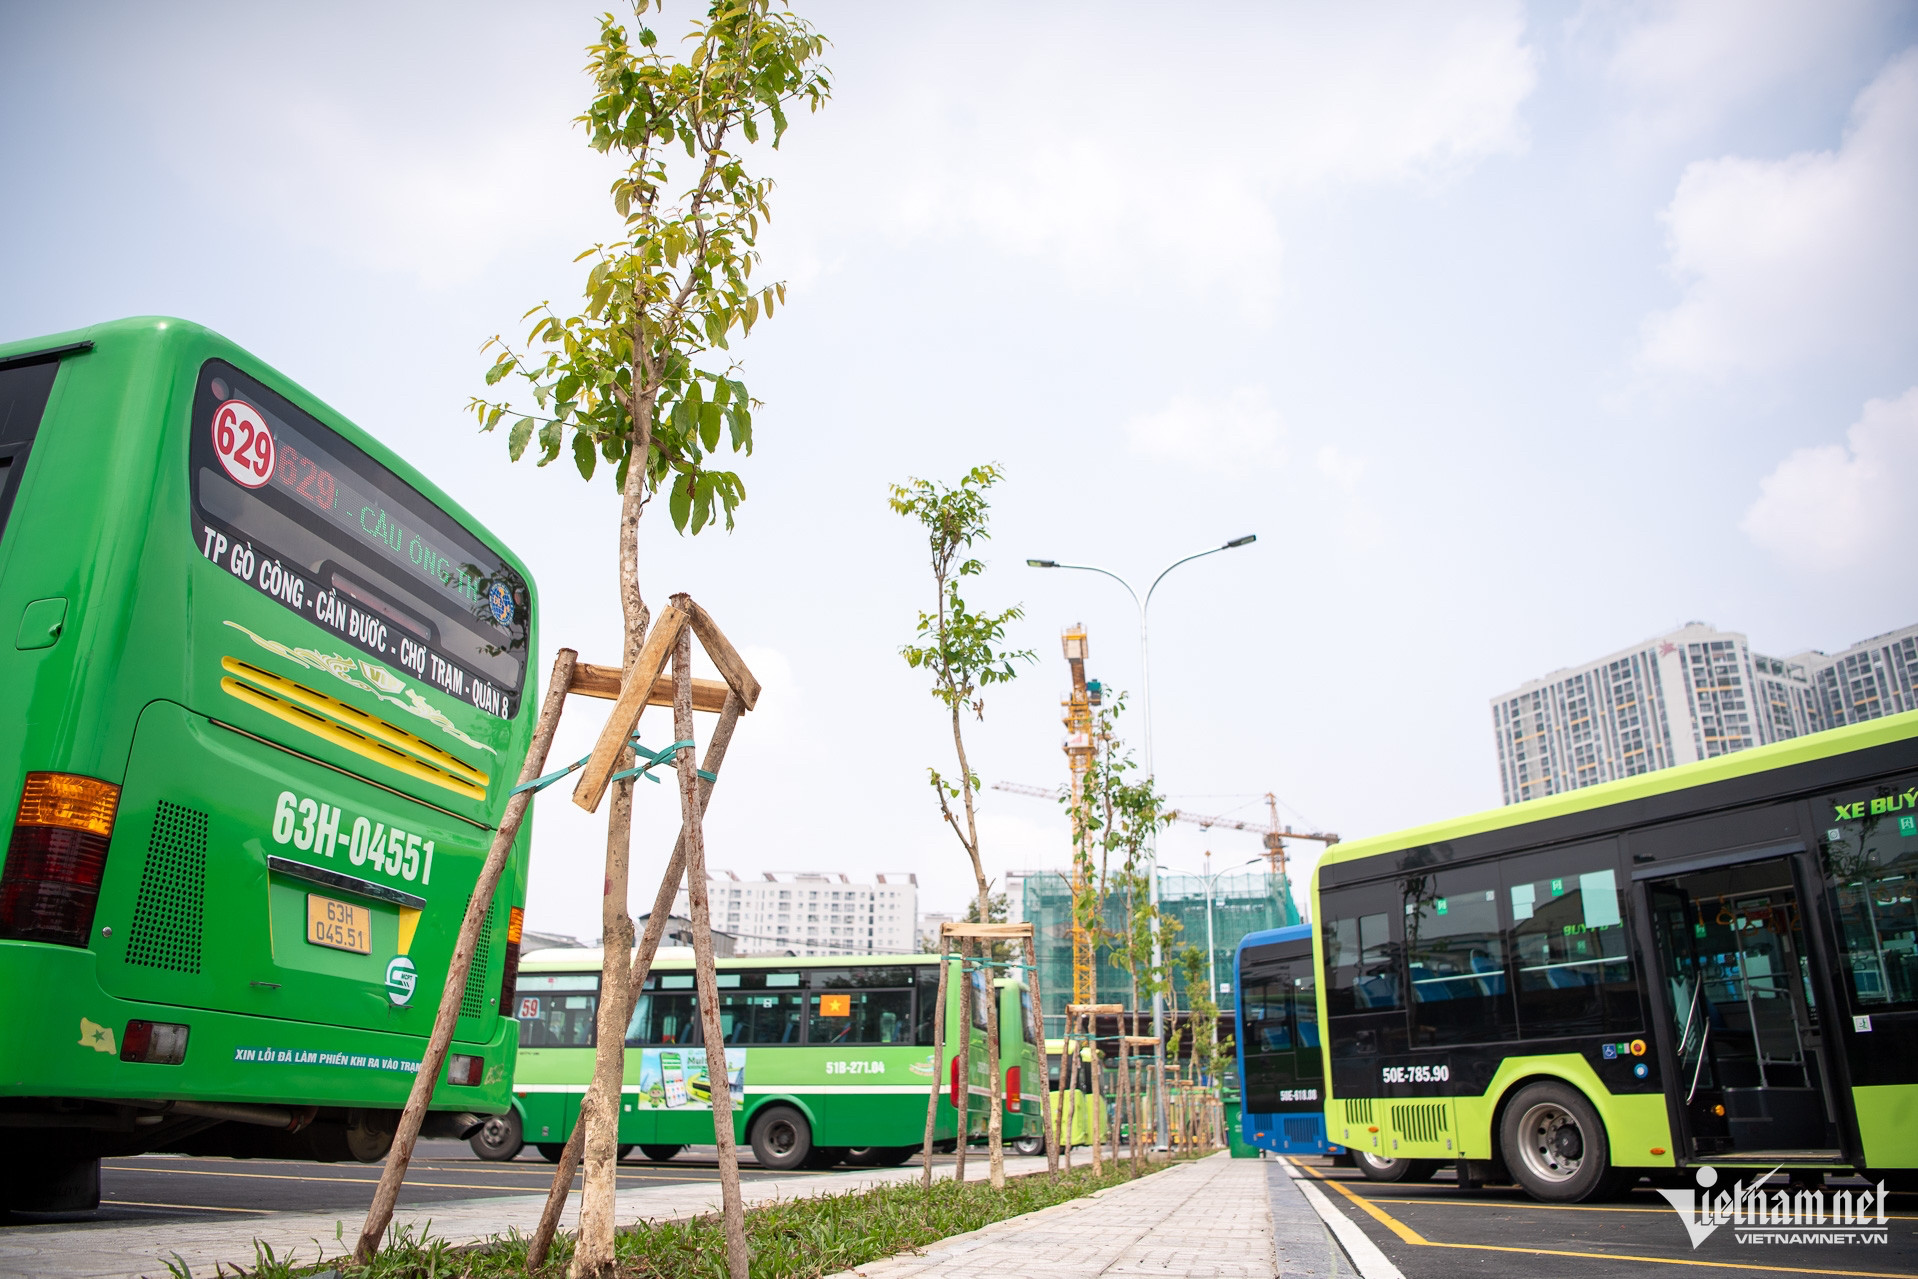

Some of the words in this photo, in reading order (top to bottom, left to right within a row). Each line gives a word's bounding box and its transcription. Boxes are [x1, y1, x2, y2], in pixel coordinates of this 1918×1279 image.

[217, 408, 271, 477] 629
[279, 445, 335, 510] 629
[409, 534, 450, 584] ÔNG
[203, 525, 228, 564] TP
[230, 541, 255, 581] GÒ
[259, 559, 304, 610] CÔNG
[400, 637, 427, 680] CHỢ
[430, 653, 464, 696] TRẠM
[472, 678, 500, 716] QUẬN
[501, 696, 509, 720] 8
[1834, 801, 1866, 822] XE
[1870, 786, 1918, 815] BUÝ
[272, 790, 435, 886] 63H-04551
[327, 902, 354, 926] 63H
[316, 921, 363, 949] 045.51
[521, 999, 539, 1017] 59
[234, 1048, 256, 1061] XIN
[257, 1046, 275, 1062] LỖI
[277, 1050, 293, 1062] ĐÃ
[294, 1050, 317, 1064] LÀM
[350, 1056, 366, 1067] KHI
[367, 1057, 380, 1069] RA
[381, 1057, 399, 1070] VÀO
[1382, 1065, 1450, 1083] 50E-785.90
